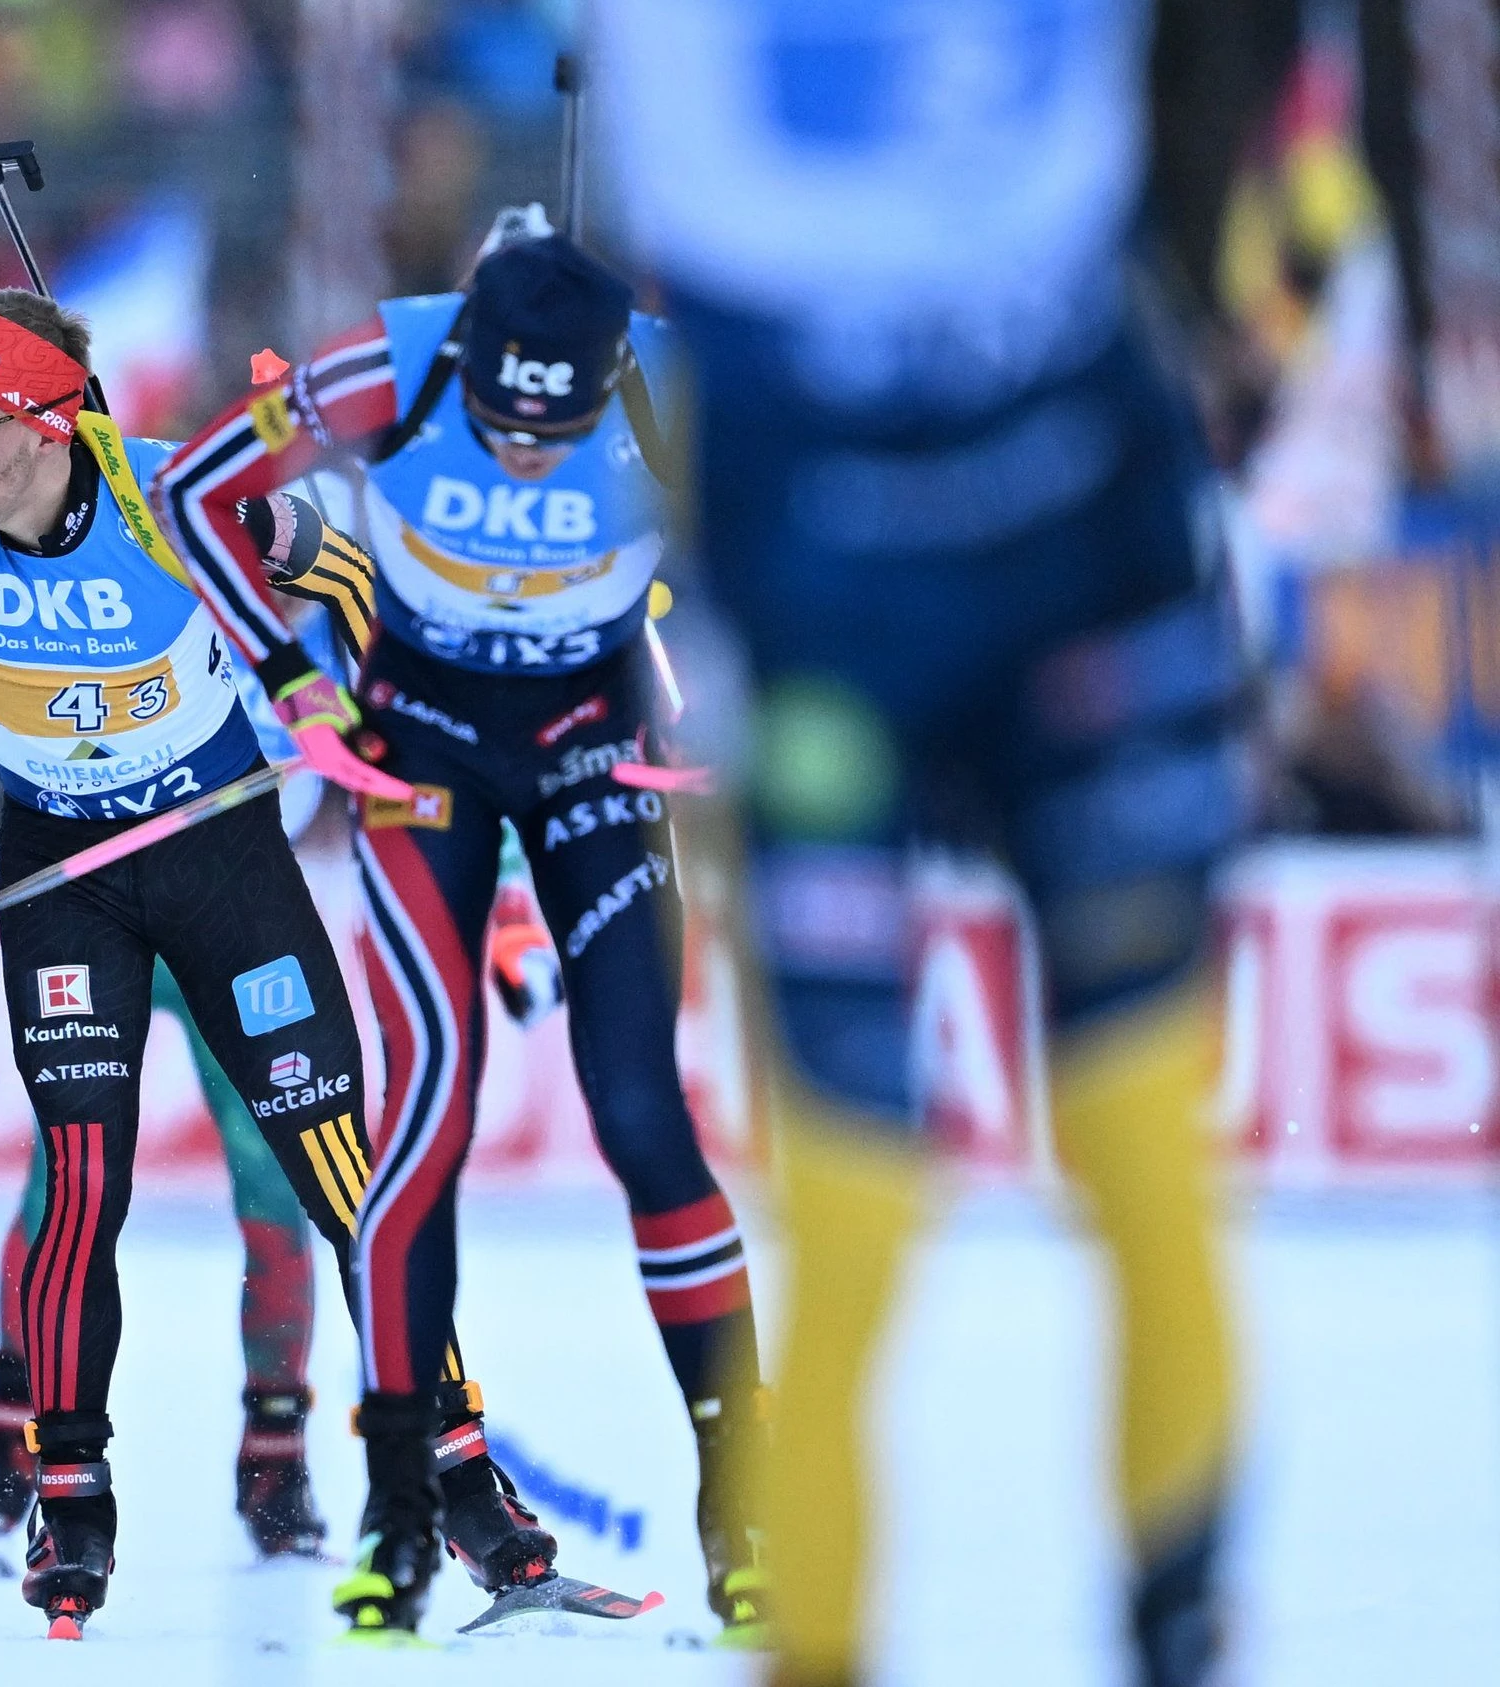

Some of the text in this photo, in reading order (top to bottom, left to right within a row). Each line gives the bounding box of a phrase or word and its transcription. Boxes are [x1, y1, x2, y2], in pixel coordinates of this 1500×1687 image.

[497, 341, 575, 397] ice
[421, 474, 598, 543] DKB
[34, 635, 81, 655] kann
[87, 636, 139, 655] Bank
[46, 674, 169, 734] 4 3
[545, 790, 664, 851] ASKO
[243, 969, 302, 1019] TQ
[24, 1021, 120, 1044] Kaufland
[59, 1061, 130, 1081] TERREX
[252, 1073, 351, 1119] tectake
[41, 1472, 97, 1486] ROSSIGNOL
